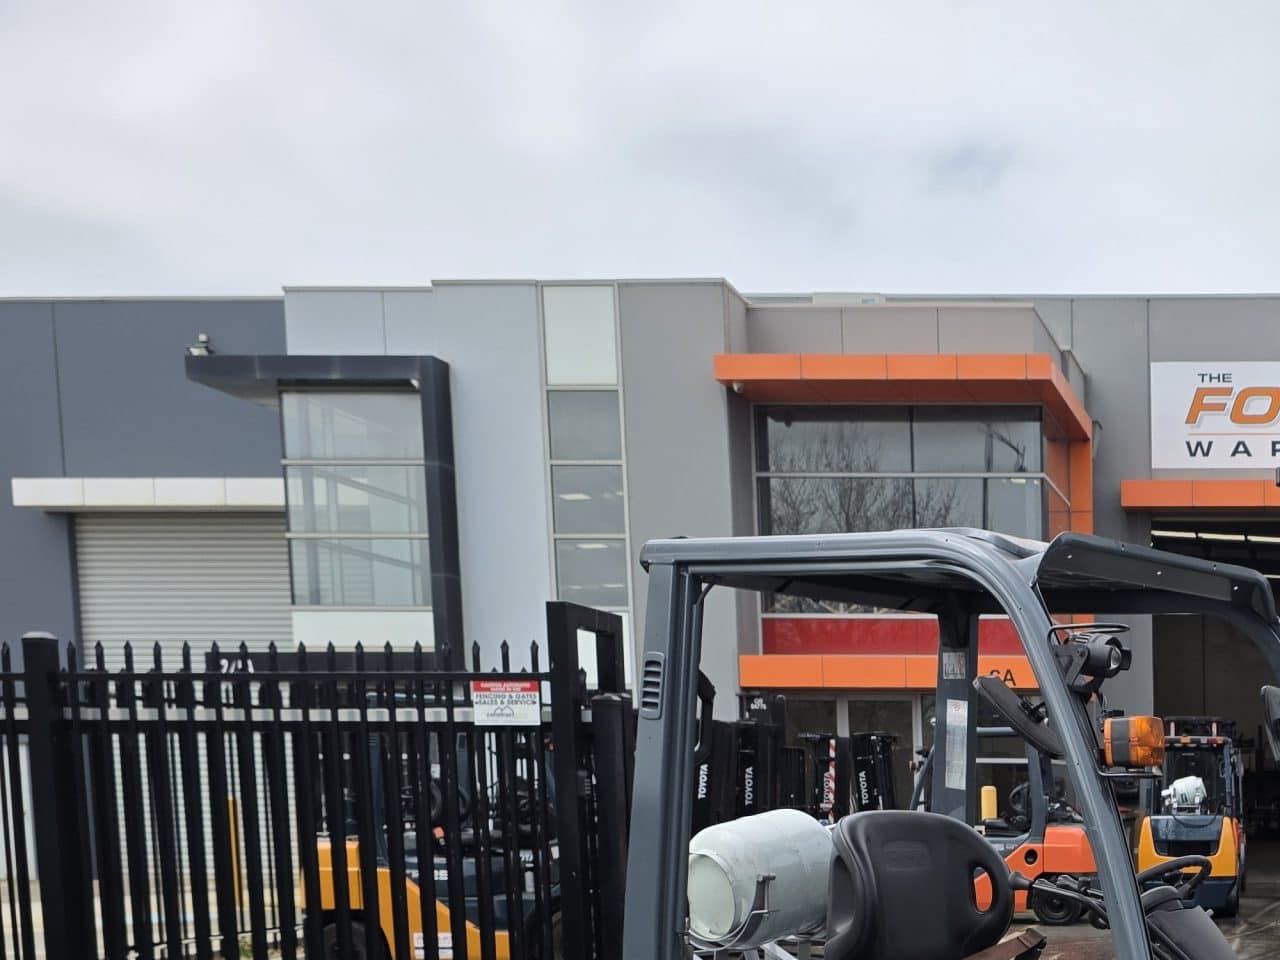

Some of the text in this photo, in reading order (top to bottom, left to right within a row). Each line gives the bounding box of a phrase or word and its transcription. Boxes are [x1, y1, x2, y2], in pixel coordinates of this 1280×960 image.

[1197, 373, 1233, 383] THE
[697, 763, 709, 800] TOYOTA
[744, 766, 754, 806] TOYOTA
[858, 770, 868, 805] TOYOTA
